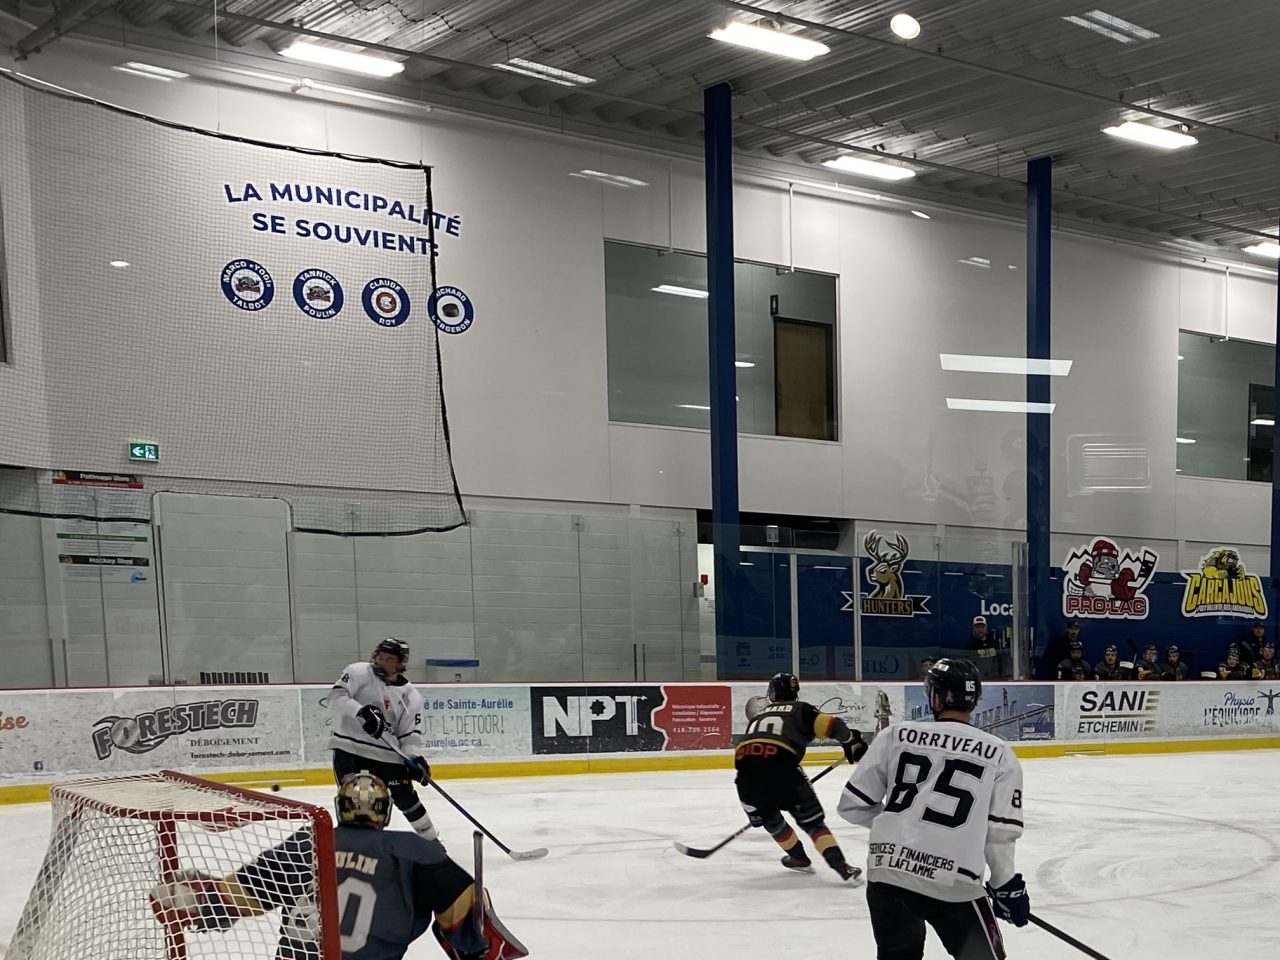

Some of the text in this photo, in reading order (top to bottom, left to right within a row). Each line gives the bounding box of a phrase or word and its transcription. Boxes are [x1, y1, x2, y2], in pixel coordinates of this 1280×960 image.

[224, 183, 461, 237] LA MUNICIPALITÉ
[252, 213, 286, 234] SE
[299, 271, 337, 286] YANNICK
[369, 279, 401, 292] CLAUDE
[232, 296, 267, 309] TALBOT
[304, 304, 336, 318] POULIN
[379, 318, 396, 326] ROY
[1185, 574, 1266, 613] CARCAJOUS
[863, 600, 911, 615] HUNTERS
[980, 600, 1015, 616] Loca
[433, 700, 444, 710] de
[447, 699, 514, 710] Sainte-Aurélie
[1224, 692, 1256, 709] Physio
[543, 696, 643, 737] NPT
[92, 699, 259, 760] FORESTECH
[1078, 721, 1139, 733] ETCHEMIN
[899, 728, 998, 760] CORRIVEAU
[883, 751, 985, 829] 85
[334, 851, 379, 876] ULIN
[889, 856, 937, 880] LAFLAMME
[899, 847, 955, 871] FINANCIERS
